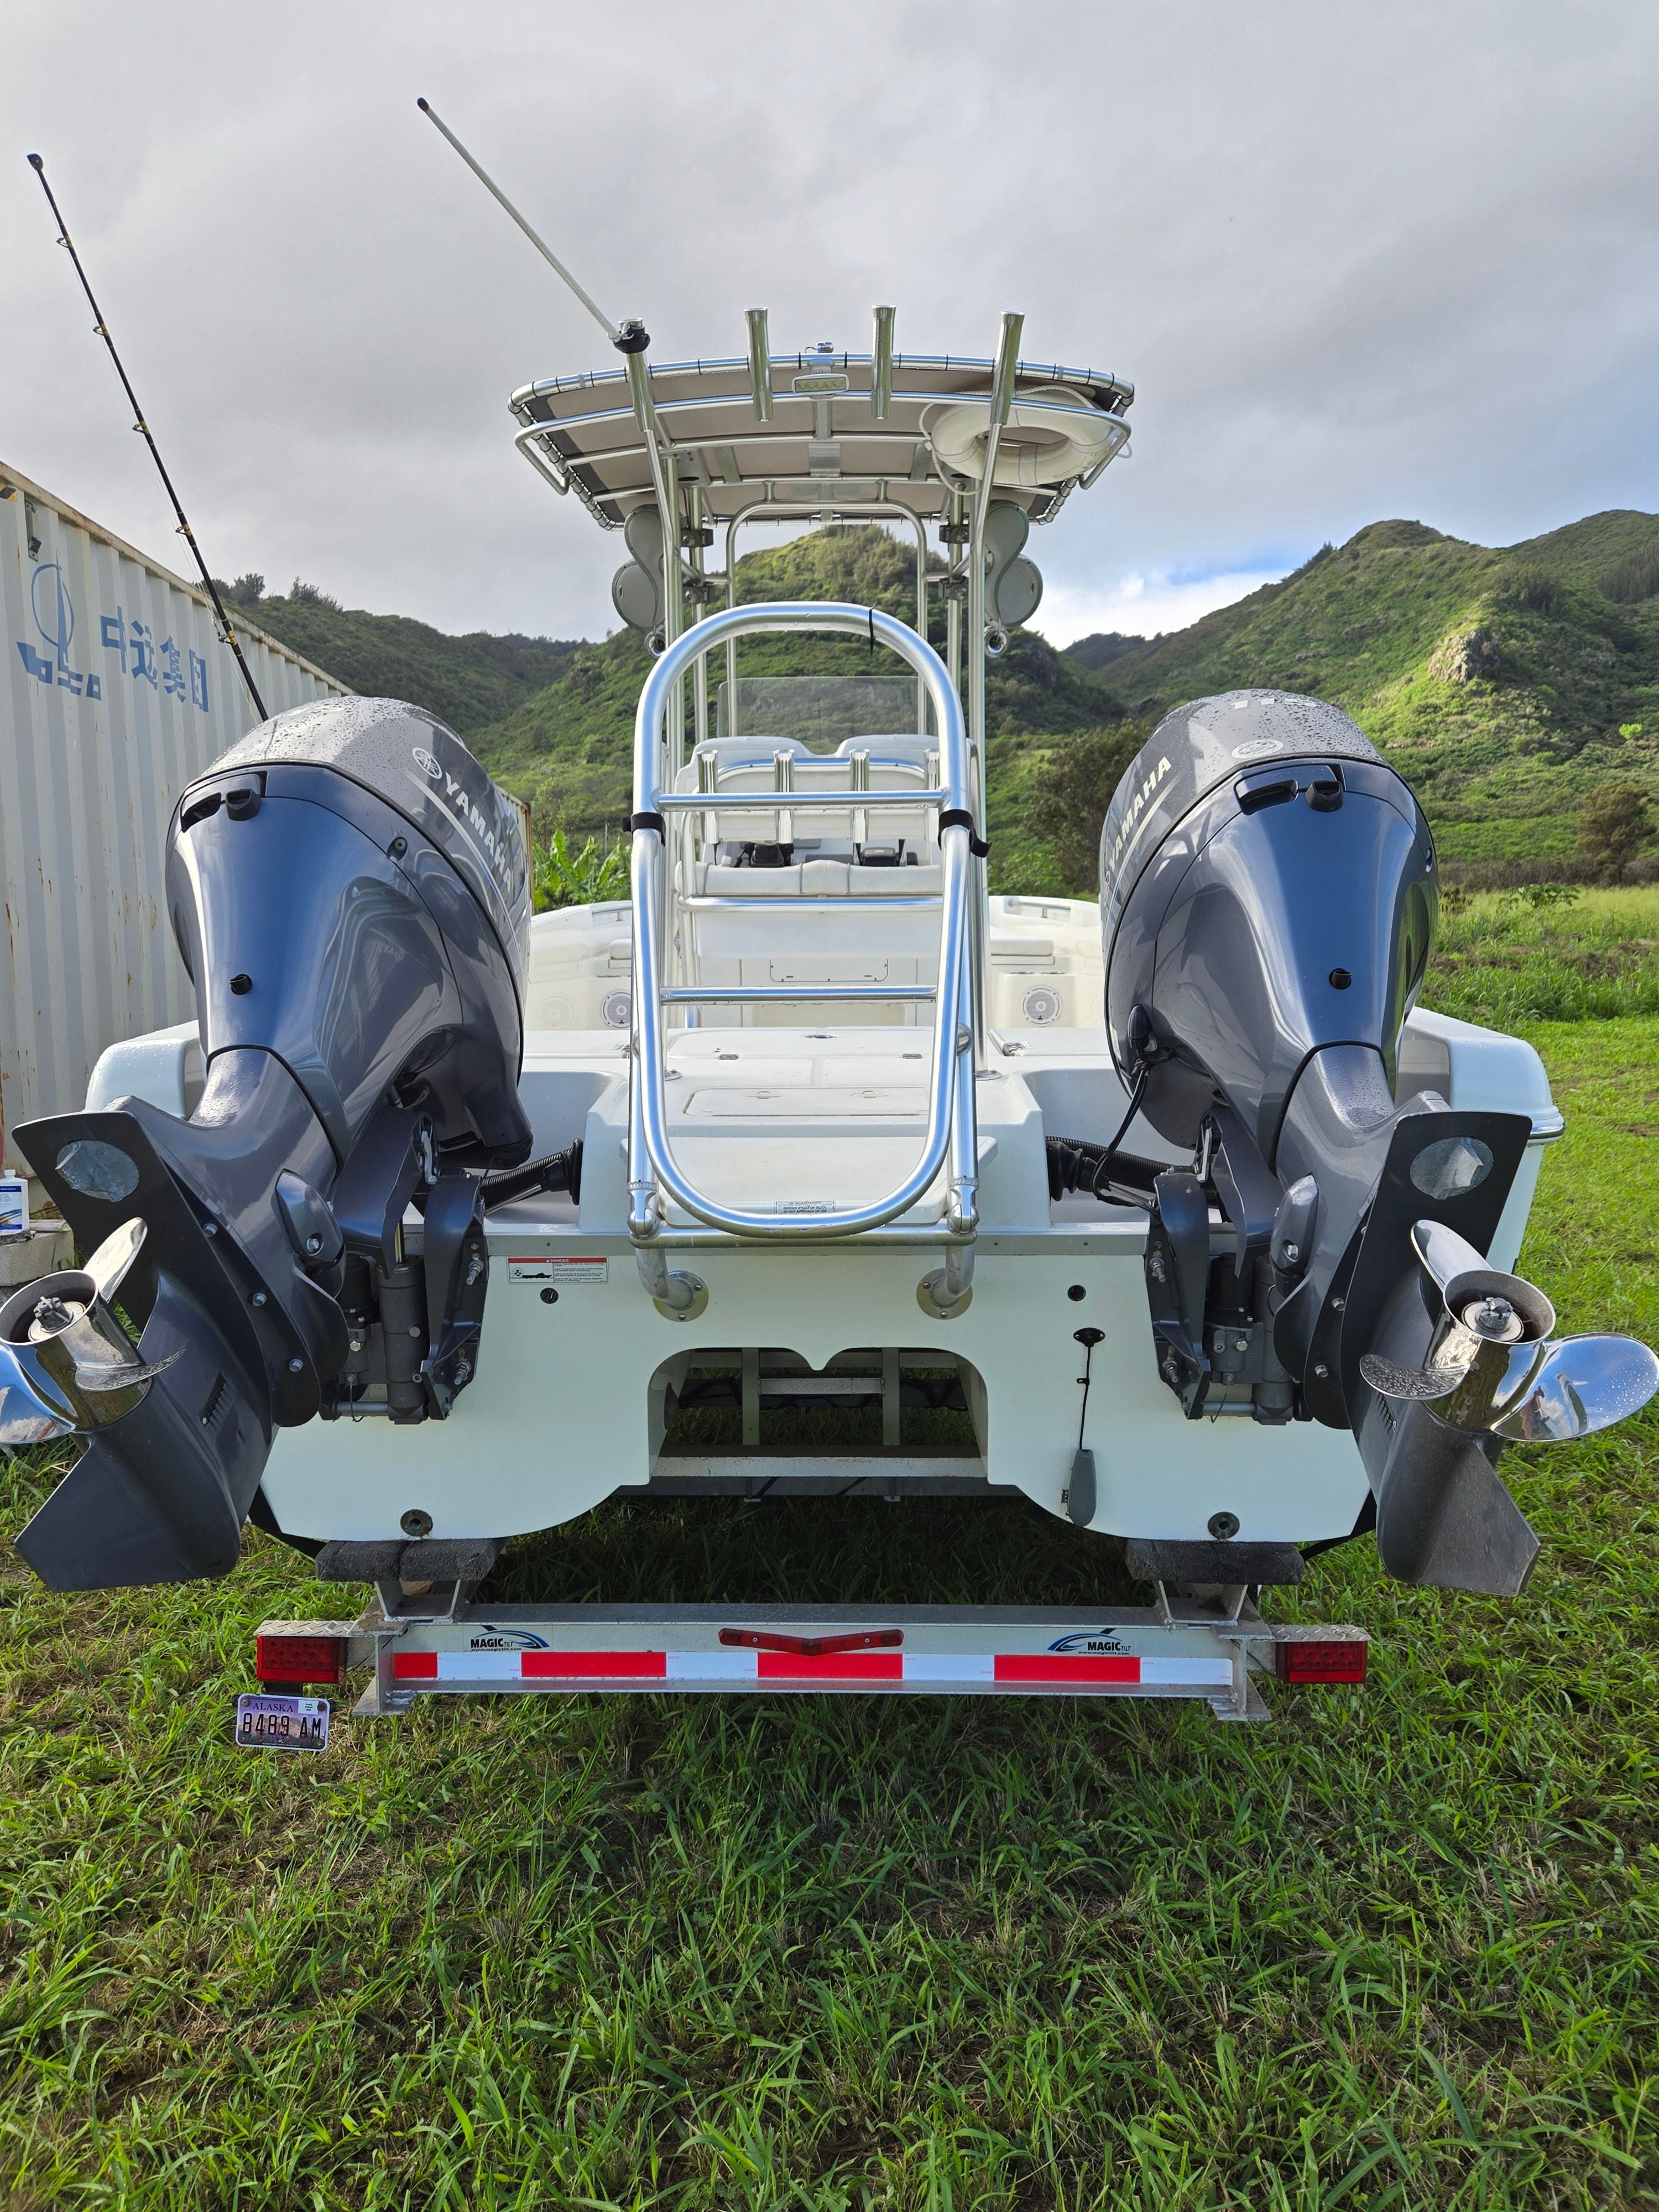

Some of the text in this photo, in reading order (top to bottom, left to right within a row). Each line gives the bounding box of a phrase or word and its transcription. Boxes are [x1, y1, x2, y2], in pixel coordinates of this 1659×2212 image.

[1109, 757, 1171, 872] YAMAHA
[446, 771, 512, 893] YAMAHA
[471, 1638, 504, 1648] MAGIC
[1087, 1642, 1121, 1651] MAGIC
[252, 1703, 294, 1712] ALASKA
[243, 1713, 321, 1739] 8489 AM
